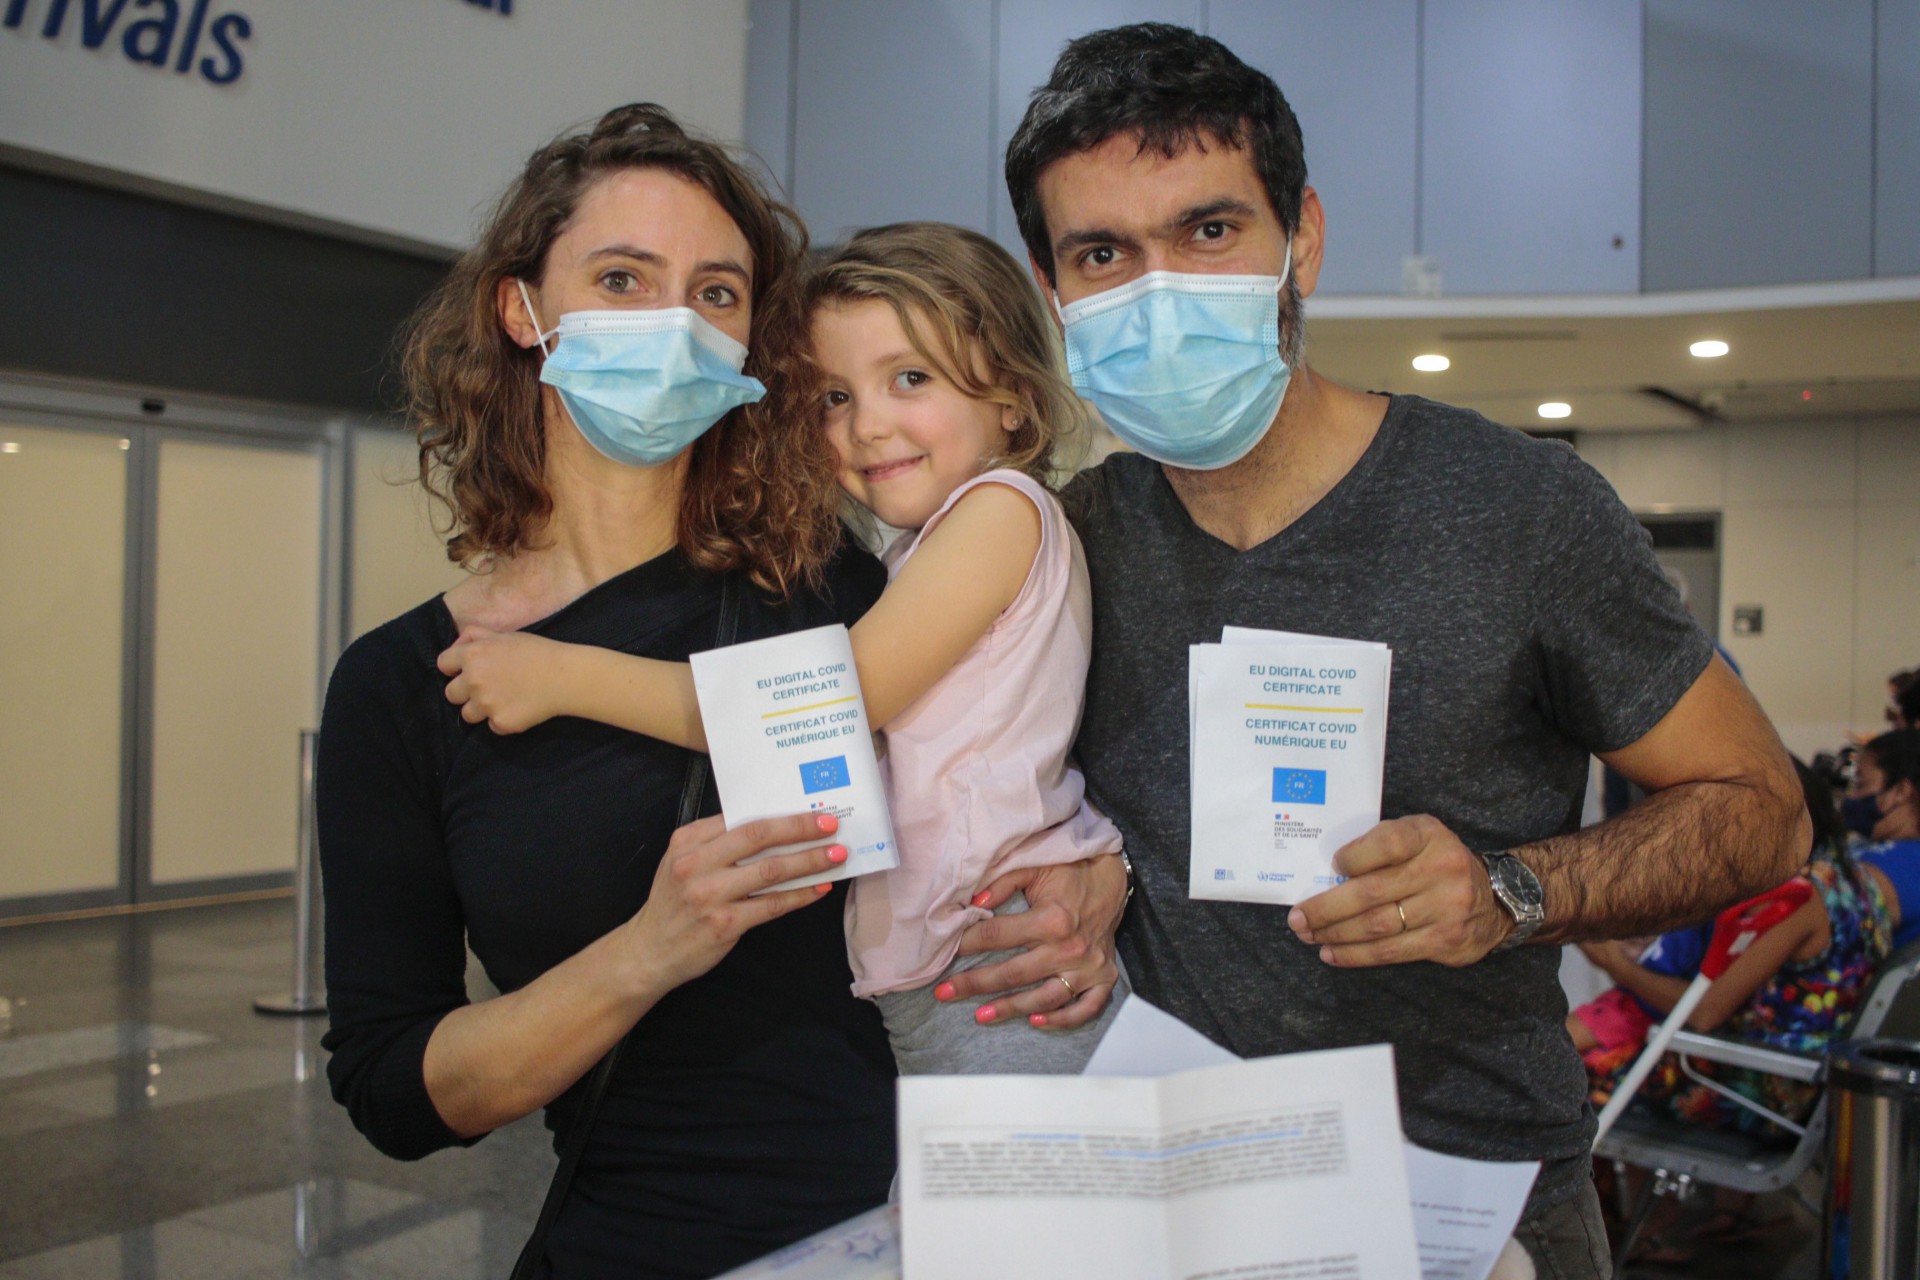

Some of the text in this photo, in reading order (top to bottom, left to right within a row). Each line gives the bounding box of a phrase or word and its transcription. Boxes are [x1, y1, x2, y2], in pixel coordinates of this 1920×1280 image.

[757, 663, 847, 690] EU DIGITAL COVID
[1249, 665, 1357, 680] EU DIGITAL COVID
[772, 678, 841, 701] CERTIFICATE
[1263, 681, 1342, 695] CERTIFICATE
[765, 709, 858, 737] CERTIFICAT COVID
[1245, 718, 1358, 734] CERTIFICAT COVID
[776, 724, 856, 749] NUMÉRIQUE EU
[1254, 735, 1347, 750] NUMÉRIQUE EU
